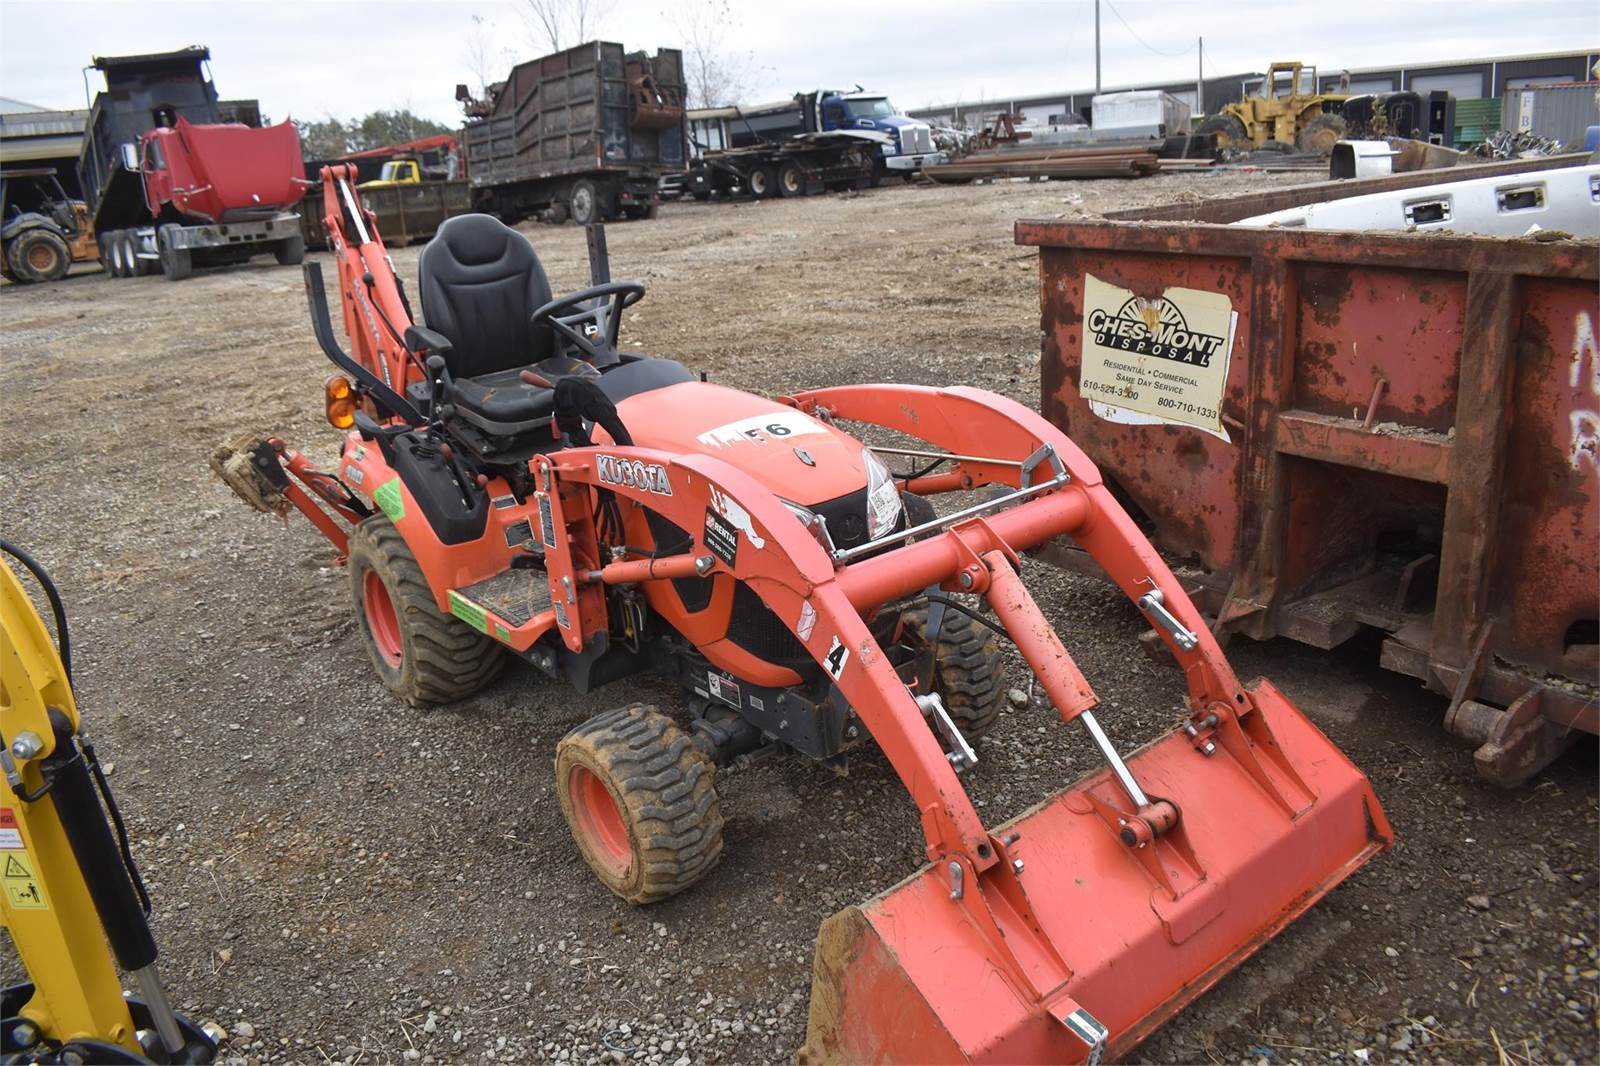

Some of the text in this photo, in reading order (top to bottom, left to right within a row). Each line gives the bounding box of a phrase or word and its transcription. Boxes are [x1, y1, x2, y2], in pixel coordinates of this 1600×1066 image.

[1089, 309, 1225, 356] CHES-MONT
[1096, 333, 1211, 366] DISPOSAL
[1103, 359, 1199, 387] RESIDENTIAL COMMERCIAL
[1116, 373, 1184, 395] SAME DAY SERVICE
[1157, 397, 1217, 419] 800-710-1333
[596, 454, 673, 496] KUBOTA
